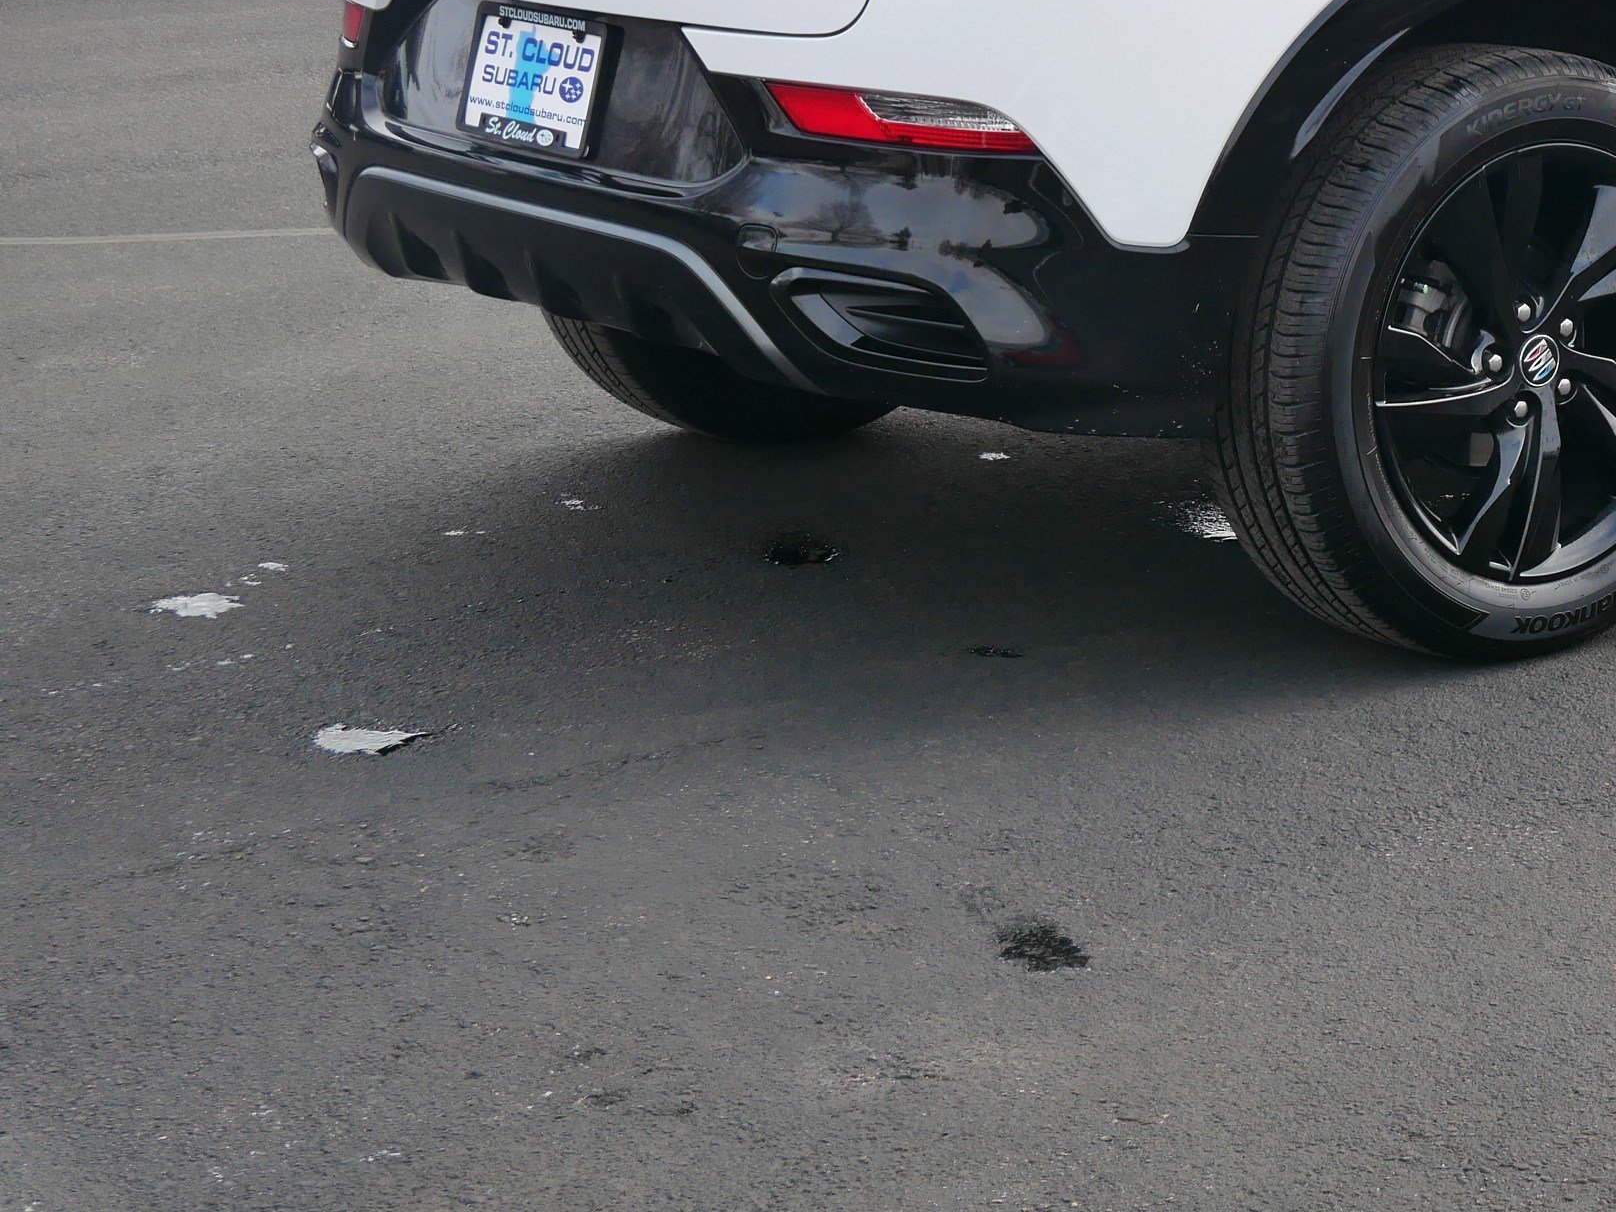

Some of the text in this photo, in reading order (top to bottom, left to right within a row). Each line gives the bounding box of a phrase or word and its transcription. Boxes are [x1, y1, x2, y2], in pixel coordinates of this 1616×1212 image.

[500, 5, 586, 31] STCLOUDSUBARU.COM
[484, 30, 595, 73] ST. CLOUD
[481, 64, 557, 95] SUBARU
[502, 120, 535, 143] Cloud
